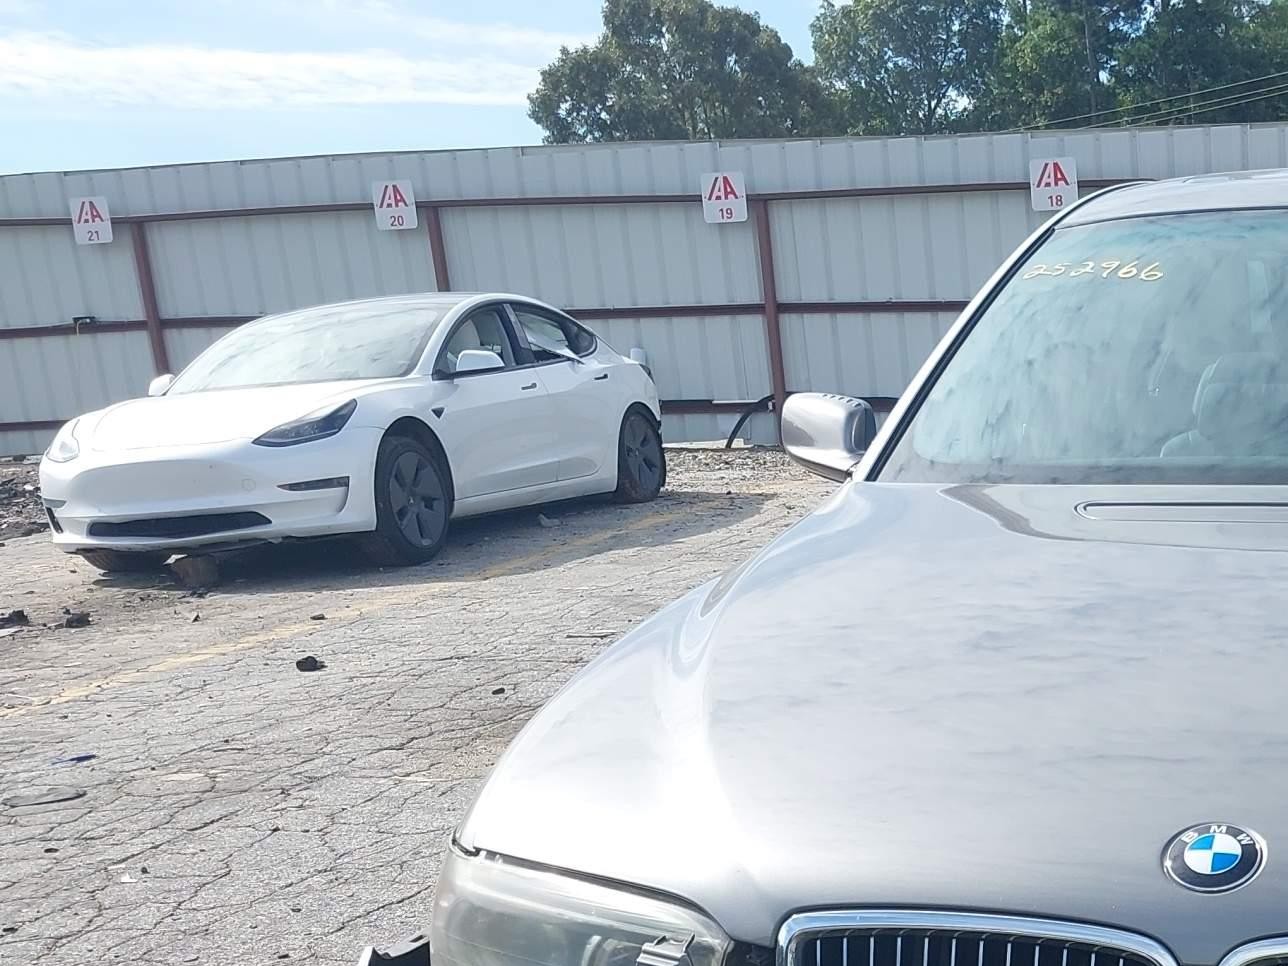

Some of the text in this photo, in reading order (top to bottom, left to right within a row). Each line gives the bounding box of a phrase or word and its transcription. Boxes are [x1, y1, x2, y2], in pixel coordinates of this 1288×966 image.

[1047, 194, 1063, 207] 18
[718, 207, 734, 220] 19
[390, 215, 404, 227] 20
[87, 230, 100, 241] 21
[1022, 260, 1164, 281] 252966
[1180, 825, 1254, 845] BMW
